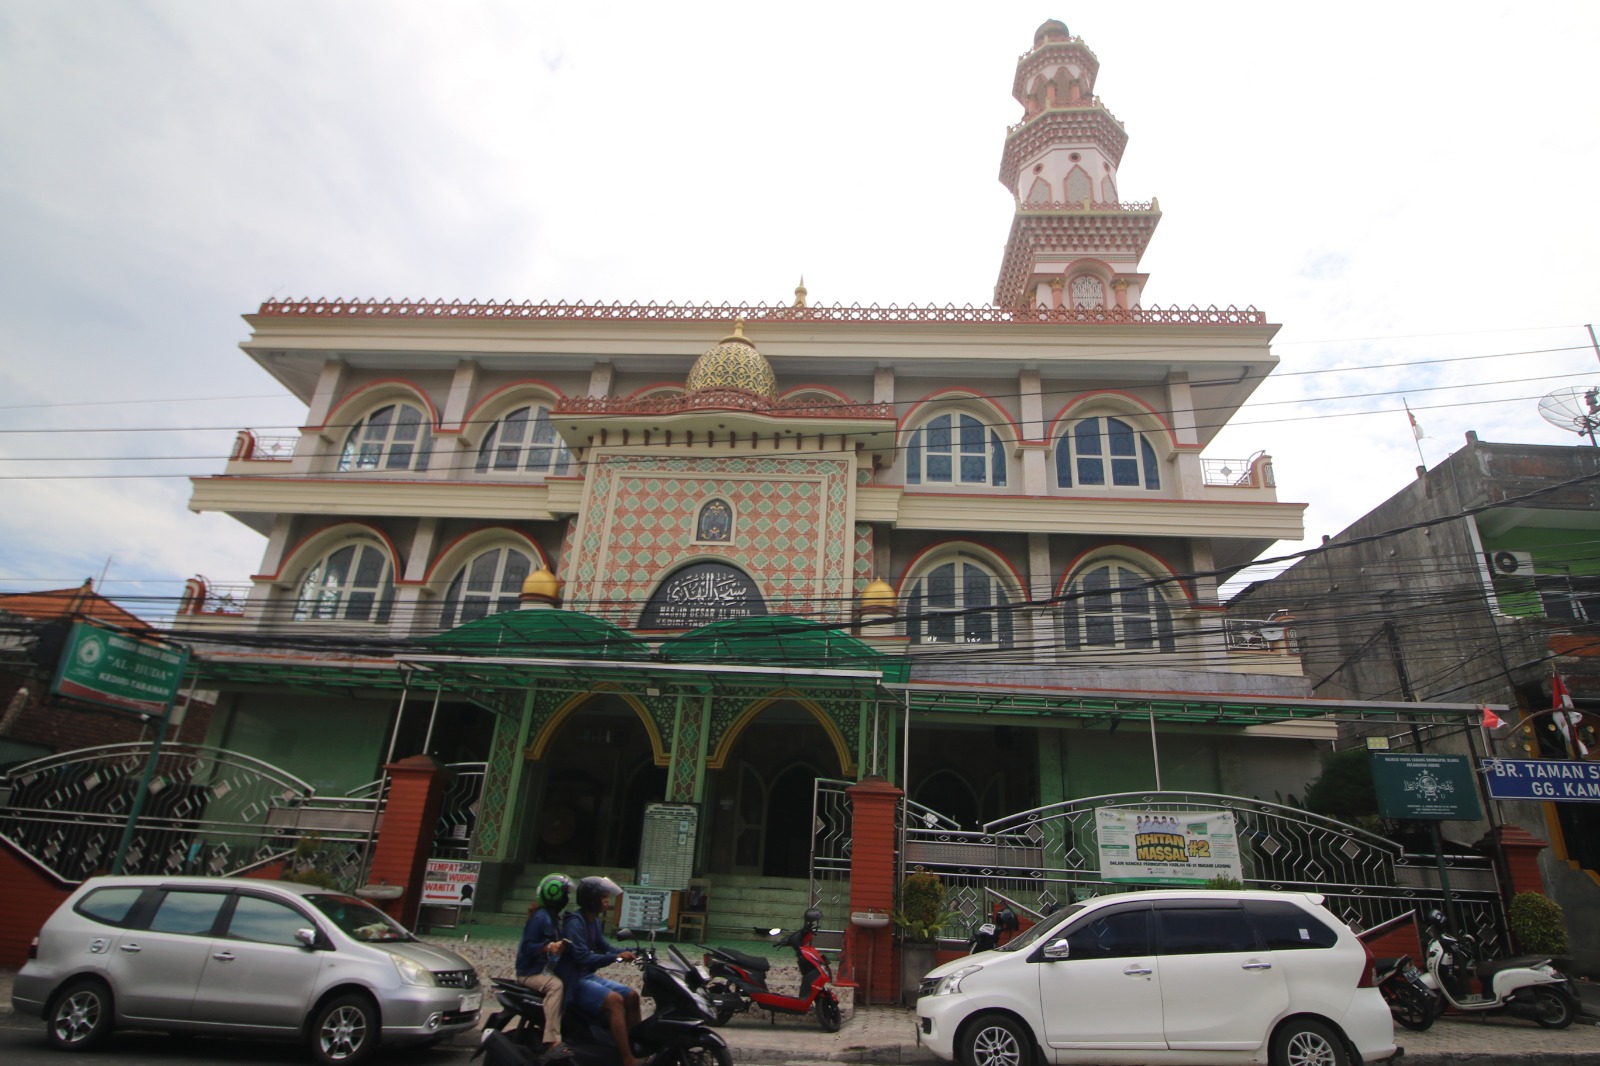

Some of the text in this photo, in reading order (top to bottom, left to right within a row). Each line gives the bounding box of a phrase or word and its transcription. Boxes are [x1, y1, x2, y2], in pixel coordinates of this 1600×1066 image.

[659, 606, 688, 617] MASJID
[689, 607, 715, 617] BESAR
[1495, 763, 1600, 780] BR. TAMAN S
[1531, 781, 1560, 796] GG.
[1135, 833, 1186, 848] KHITAN
[1136, 845, 1189, 862] MASSAL
[1188, 840, 1211, 858] #2
[428, 862, 459, 872] TEMPAT
[448, 873, 478, 883] WUDHU
[425, 882, 456, 892] WANITA
